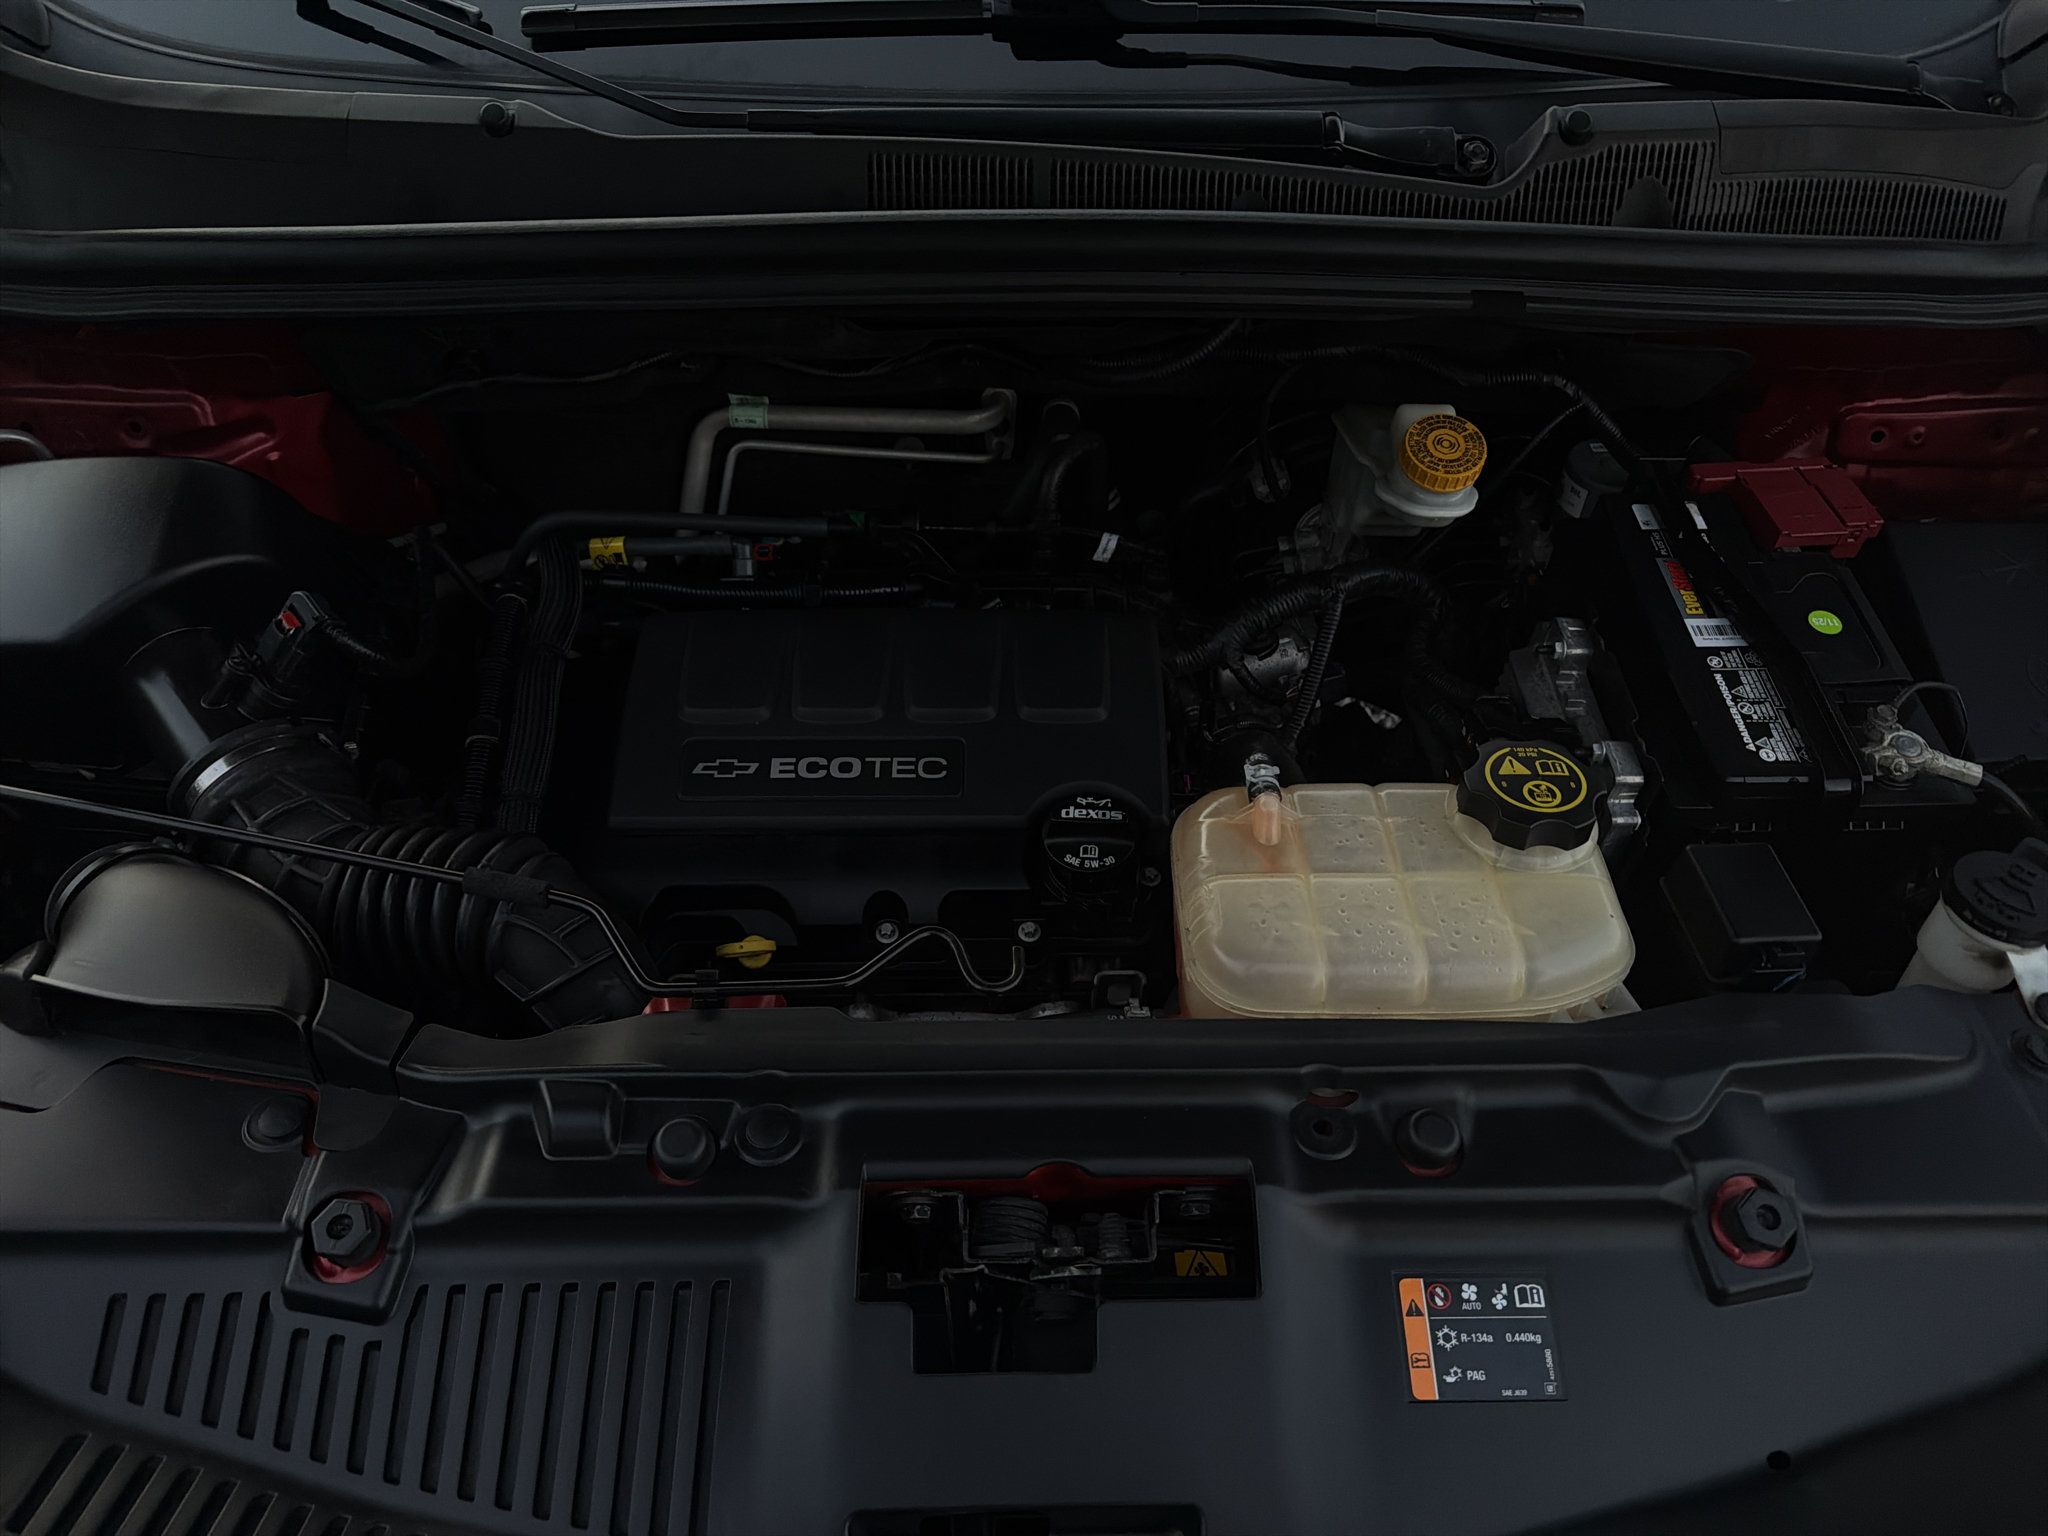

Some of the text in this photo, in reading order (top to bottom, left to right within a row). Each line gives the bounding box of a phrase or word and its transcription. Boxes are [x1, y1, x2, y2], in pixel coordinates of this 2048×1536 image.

[769, 756, 948, 779] ECOTEC
[1060, 805, 1123, 821] dexos
[1063, 853, 1116, 868] SAE 5W-30
[1462, 1302, 1482, 1310] AUTO
[1460, 1332, 1542, 1344] R-134a 0.440kg
[1466, 1370, 1486, 1381] PAG
